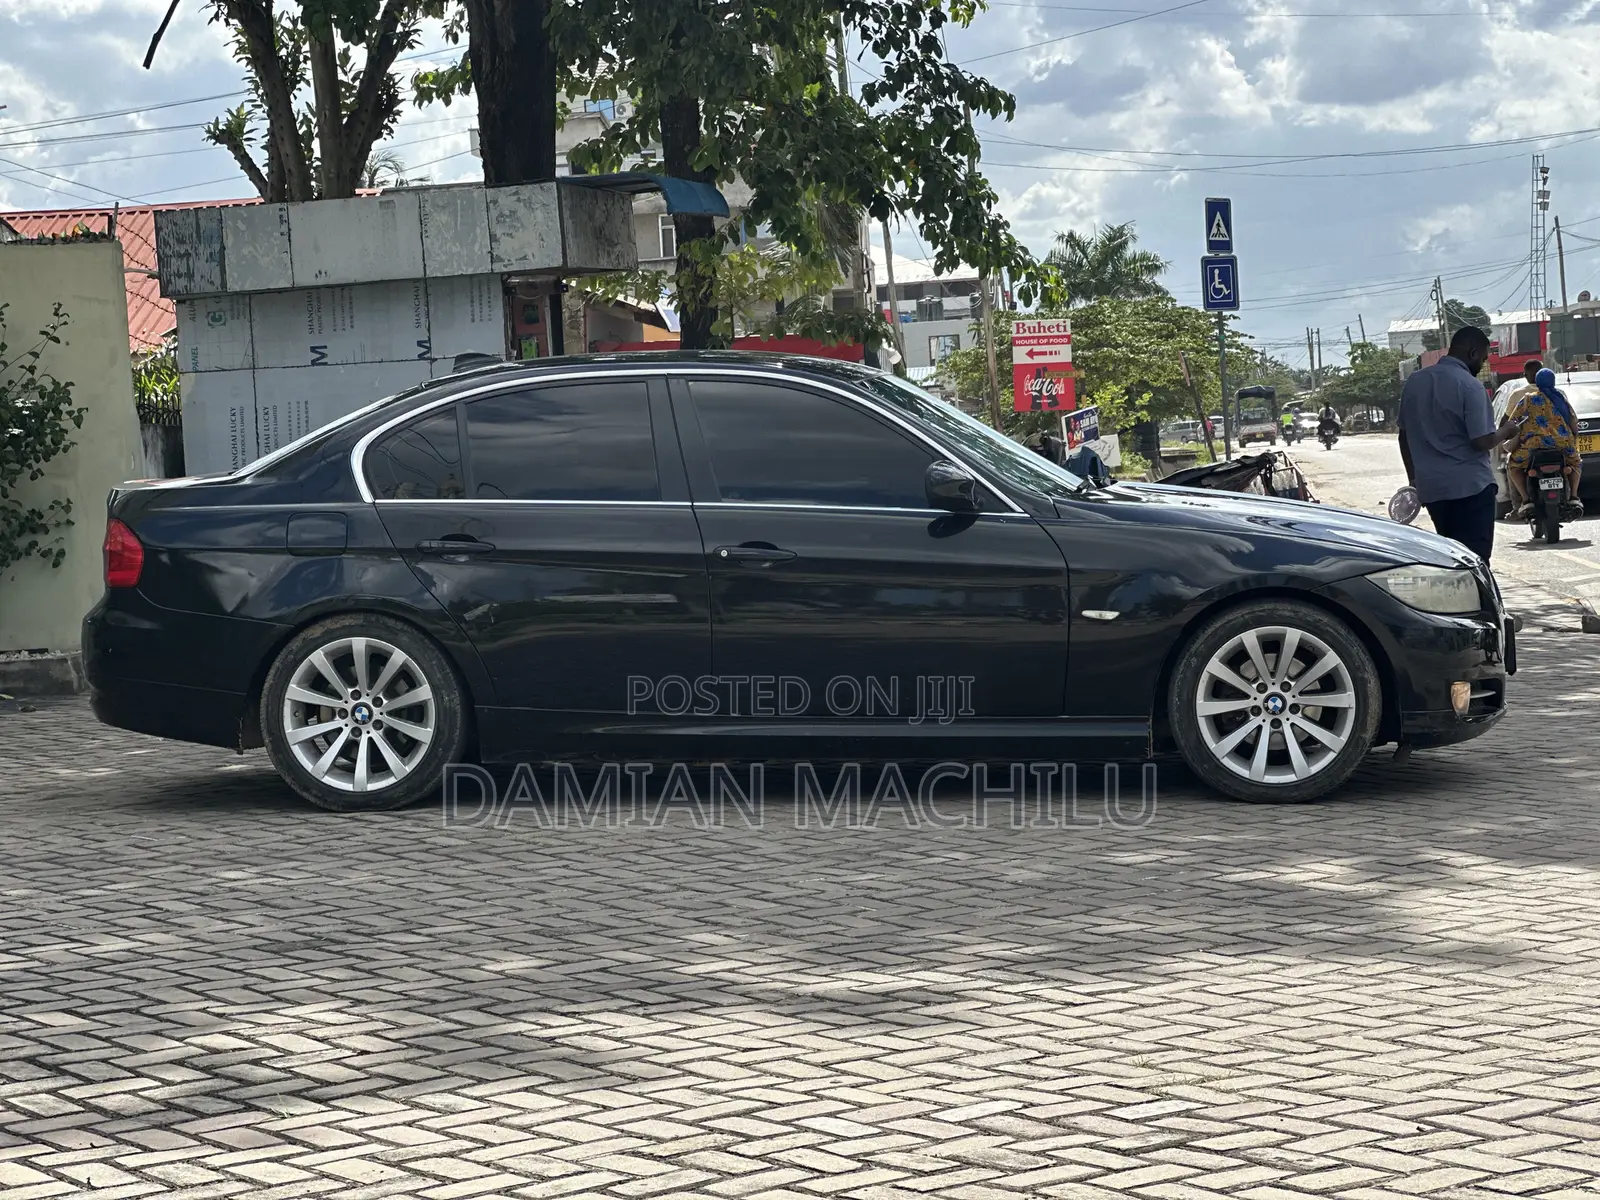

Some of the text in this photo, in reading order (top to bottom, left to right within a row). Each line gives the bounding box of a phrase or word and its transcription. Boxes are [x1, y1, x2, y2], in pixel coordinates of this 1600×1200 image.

[306, 292, 314, 335] SHANGHAI
[1015, 320, 1068, 334] Buheti
[190, 346, 198, 372] PANEL
[310, 345, 328, 366] M
[262, 405, 270, 432] LUCKY
